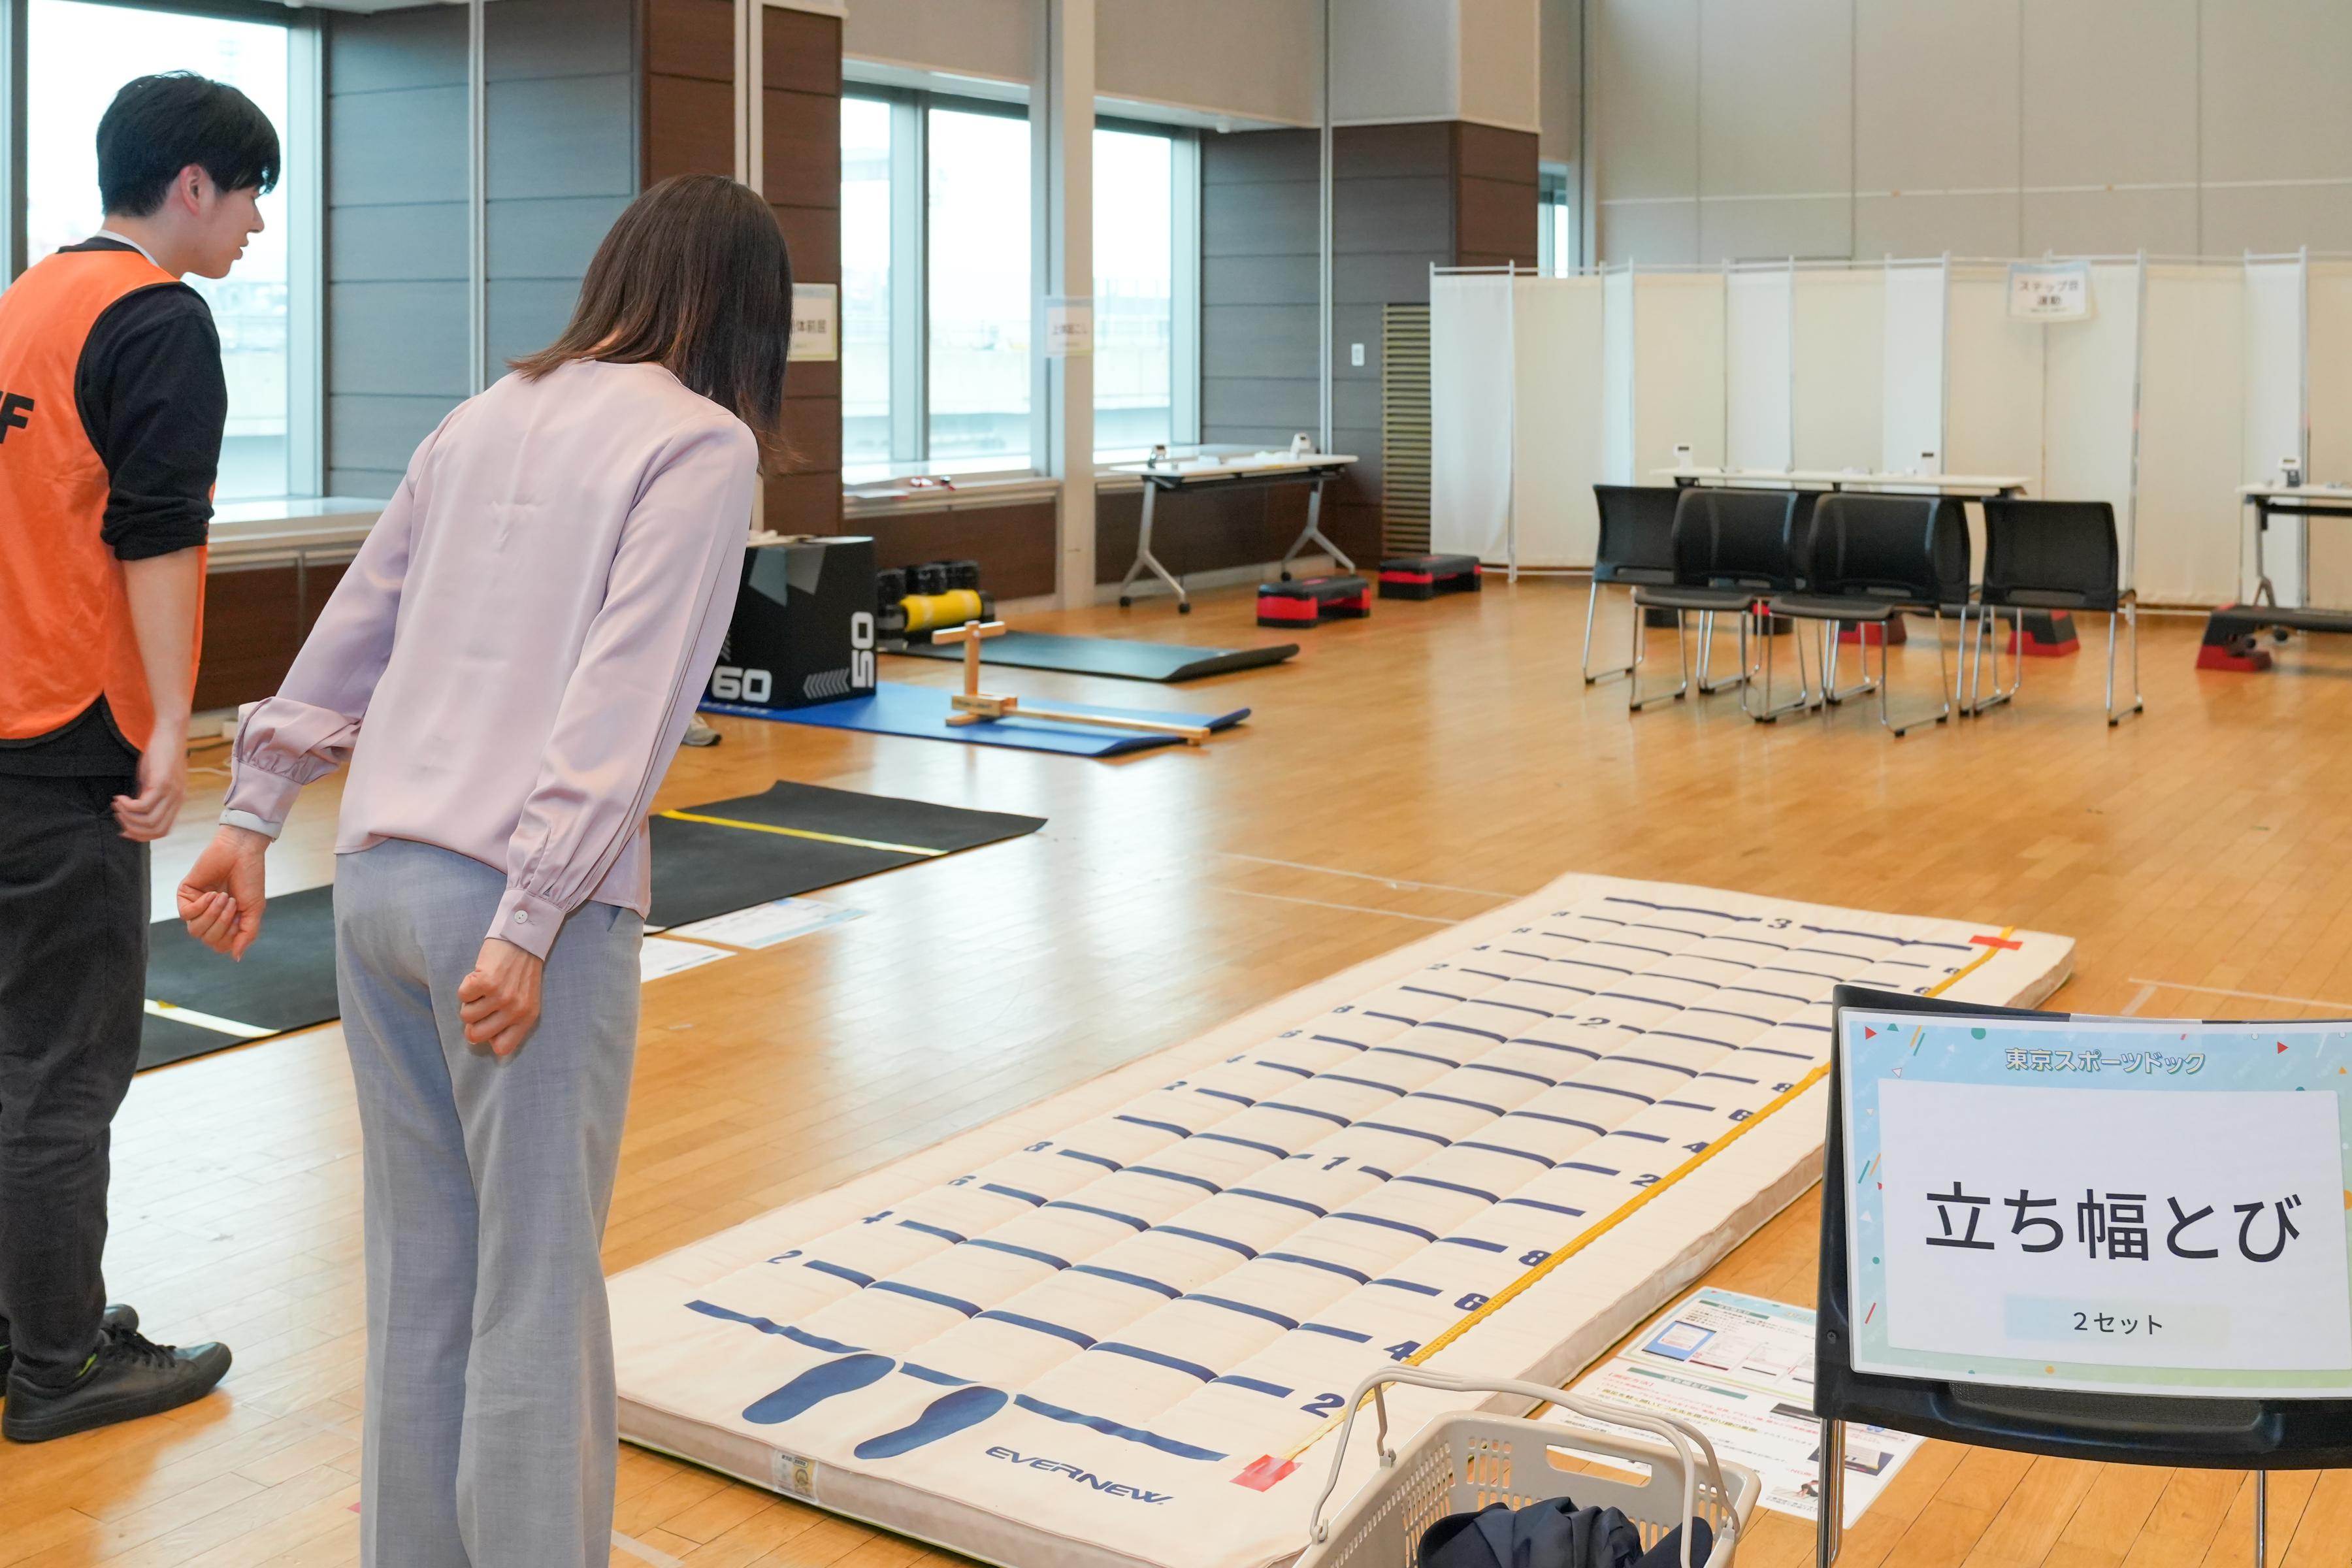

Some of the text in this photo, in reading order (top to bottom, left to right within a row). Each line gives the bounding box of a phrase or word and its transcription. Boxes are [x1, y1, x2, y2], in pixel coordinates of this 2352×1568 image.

[792, 319, 826, 334] 体前屈
[0, 391, 35, 445] F
[851, 611, 875, 689] 50
[711, 666, 772, 703] 60
[1767, 919, 1793, 930] 3
[1578, 1016, 1611, 1027] 2
[2004, 1047, 2206, 1075] 東京スポーツドック
[1161, 1080, 1188, 1092] 2
[1022, 1140, 1054, 1152] 8
[1320, 1156, 1352, 1171] 1
[947, 1174, 977, 1186] 6
[1629, 1173, 1662, 1188] 2
[861, 1209, 895, 1225] 4
[1925, 1181, 2303, 1264] 立ち幅とび
[765, 1249, 804, 1266] 2
[1518, 1249, 1553, 1267] 8
[1453, 1292, 1490, 1312] 6
[2073, 1311, 2163, 1335] 2セット
[1382, 1339, 1423, 1362] 4
[1299, 1392, 1346, 1419] 2
[985, 1445, 1174, 1505] EVERNEW
